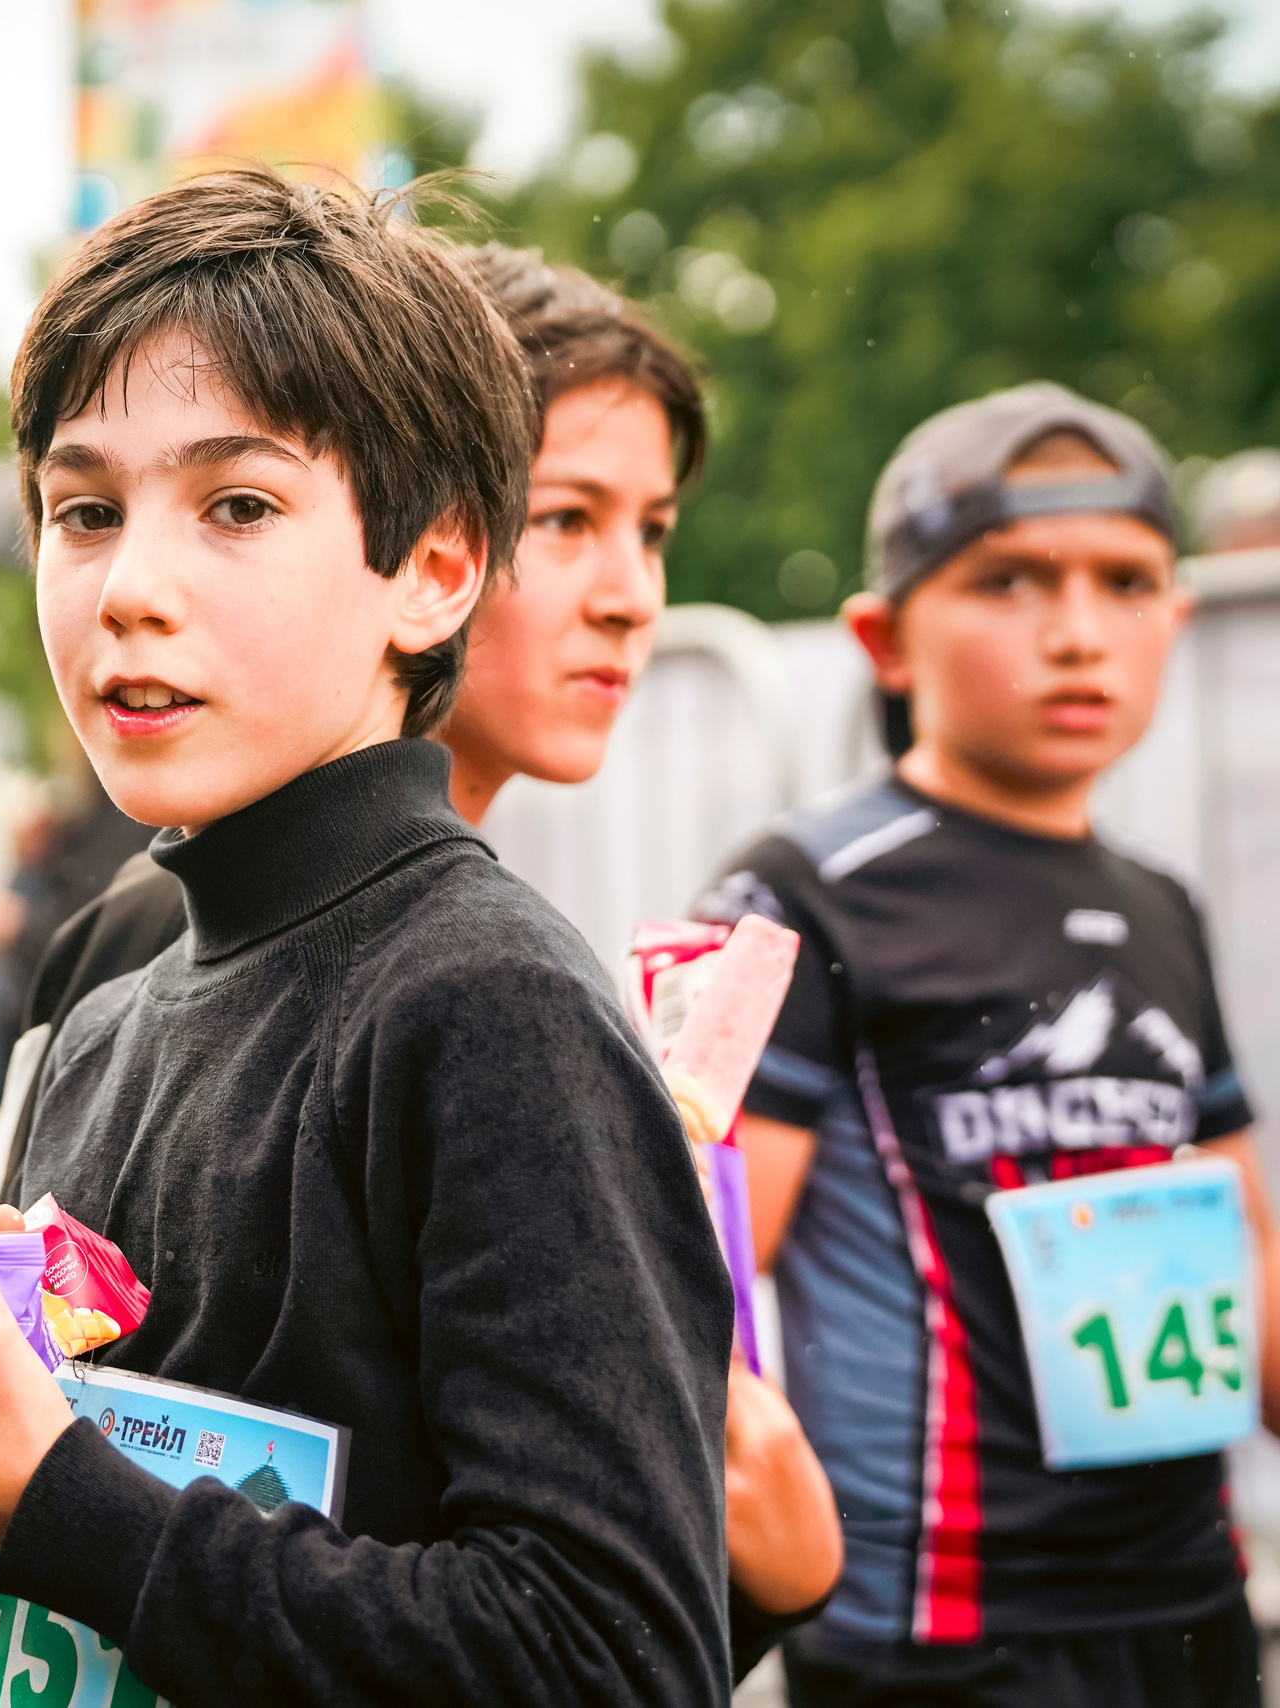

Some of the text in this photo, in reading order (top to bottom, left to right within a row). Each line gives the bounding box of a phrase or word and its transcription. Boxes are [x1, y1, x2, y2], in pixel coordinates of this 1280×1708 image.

[45, 1253, 72, 1277] СОЧНЫЕ
[49, 1260, 79, 1283] КУСОЧКИ
[53, 1271, 77, 1290] МАНГО
[1074, 1295, 1242, 1410] 145
